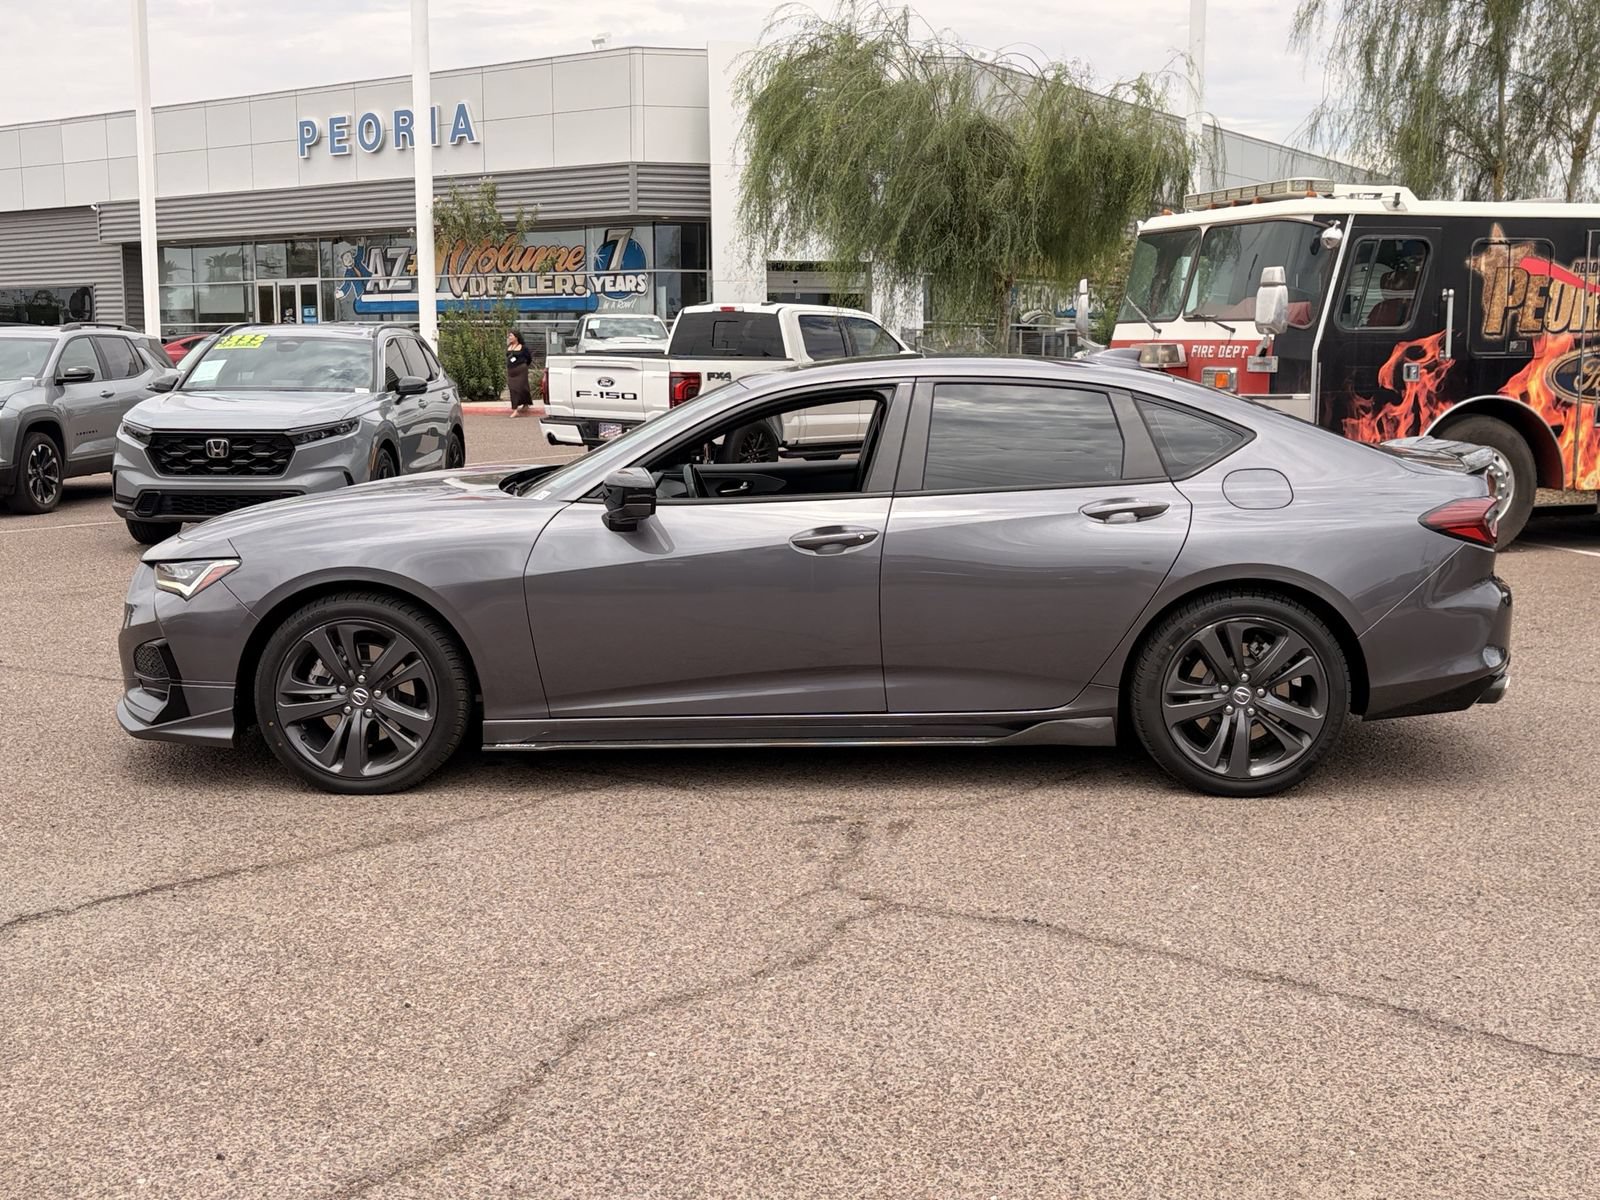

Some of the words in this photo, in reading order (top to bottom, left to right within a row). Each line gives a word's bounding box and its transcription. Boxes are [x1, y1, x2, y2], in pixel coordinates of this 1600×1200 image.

[298, 101, 480, 159] PEORIA
[604, 227, 633, 272] 7
[365, 246, 412, 291] AZ
[467, 274, 586, 297] DEALER!
[591, 274, 646, 293] YEARS
[1190, 344, 1216, 358] FIRE
[1217, 344, 1249, 359] DEPT
[707, 371, 732, 381] FX4
[576, 390, 637, 400] F-150
